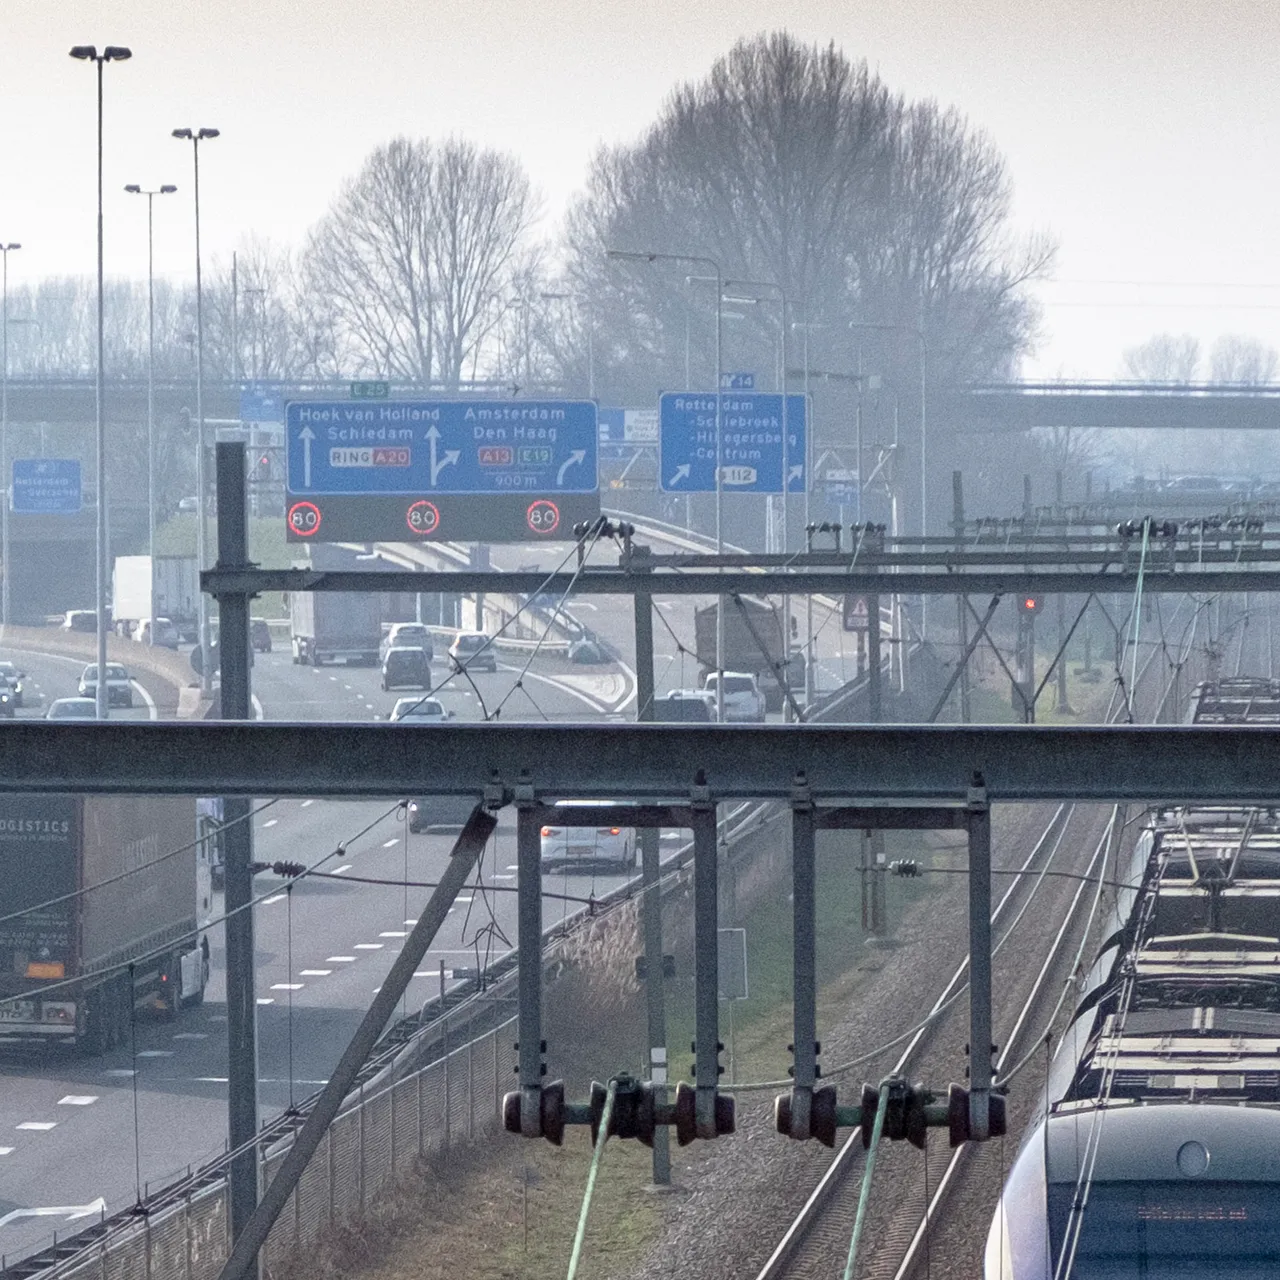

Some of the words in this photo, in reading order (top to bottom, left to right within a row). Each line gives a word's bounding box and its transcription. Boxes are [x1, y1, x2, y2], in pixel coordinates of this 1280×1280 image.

[675, 399, 754, 411] Rottedam
[299, 408, 340, 421] Hoek
[345, 411, 374, 421] van
[380, 407, 440, 421] Holland
[464, 406, 566, 420] Amsterdam
[690, 416, 779, 428] -Sciebroek
[327, 427, 414, 440] Schiedam
[473, 427, 510, 439] Den
[513, 427, 557, 441] Haag
[332, 451, 370, 463] RING
[376, 451, 408, 463] A20
[482, 450, 510, 462] A13
[522, 450, 549, 462] E19
[690, 448, 762, 460] -Cetrum
[495, 476, 520, 487] 900
[292, 512, 317, 525] 80
[410, 511, 435, 525] 80
[529, 510, 555, 524] 80
